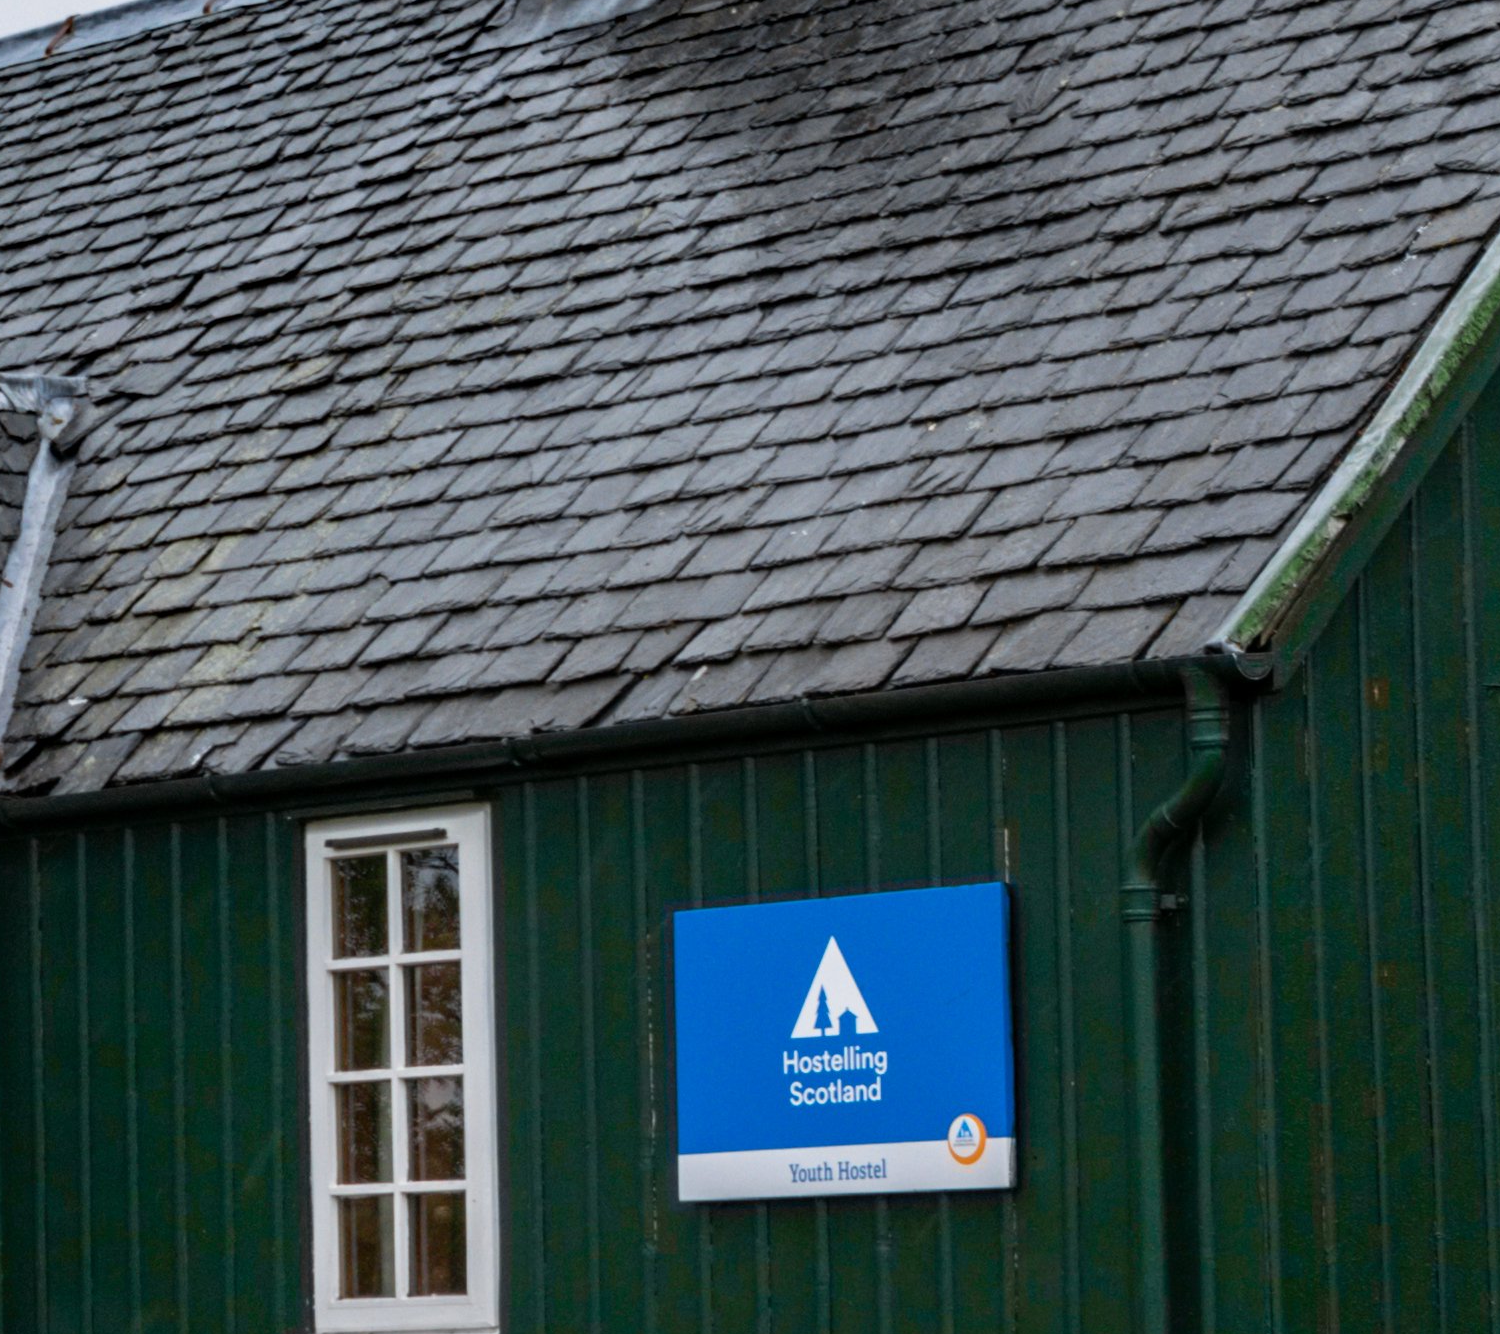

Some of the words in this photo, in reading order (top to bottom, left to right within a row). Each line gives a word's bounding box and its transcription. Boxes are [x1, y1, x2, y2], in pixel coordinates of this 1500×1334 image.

[783, 1046, 887, 1075] Hostelling
[790, 1076, 881, 1106] Scotland
[789, 1162, 833, 1183] Youth
[838, 1158, 887, 1181] Hostel
